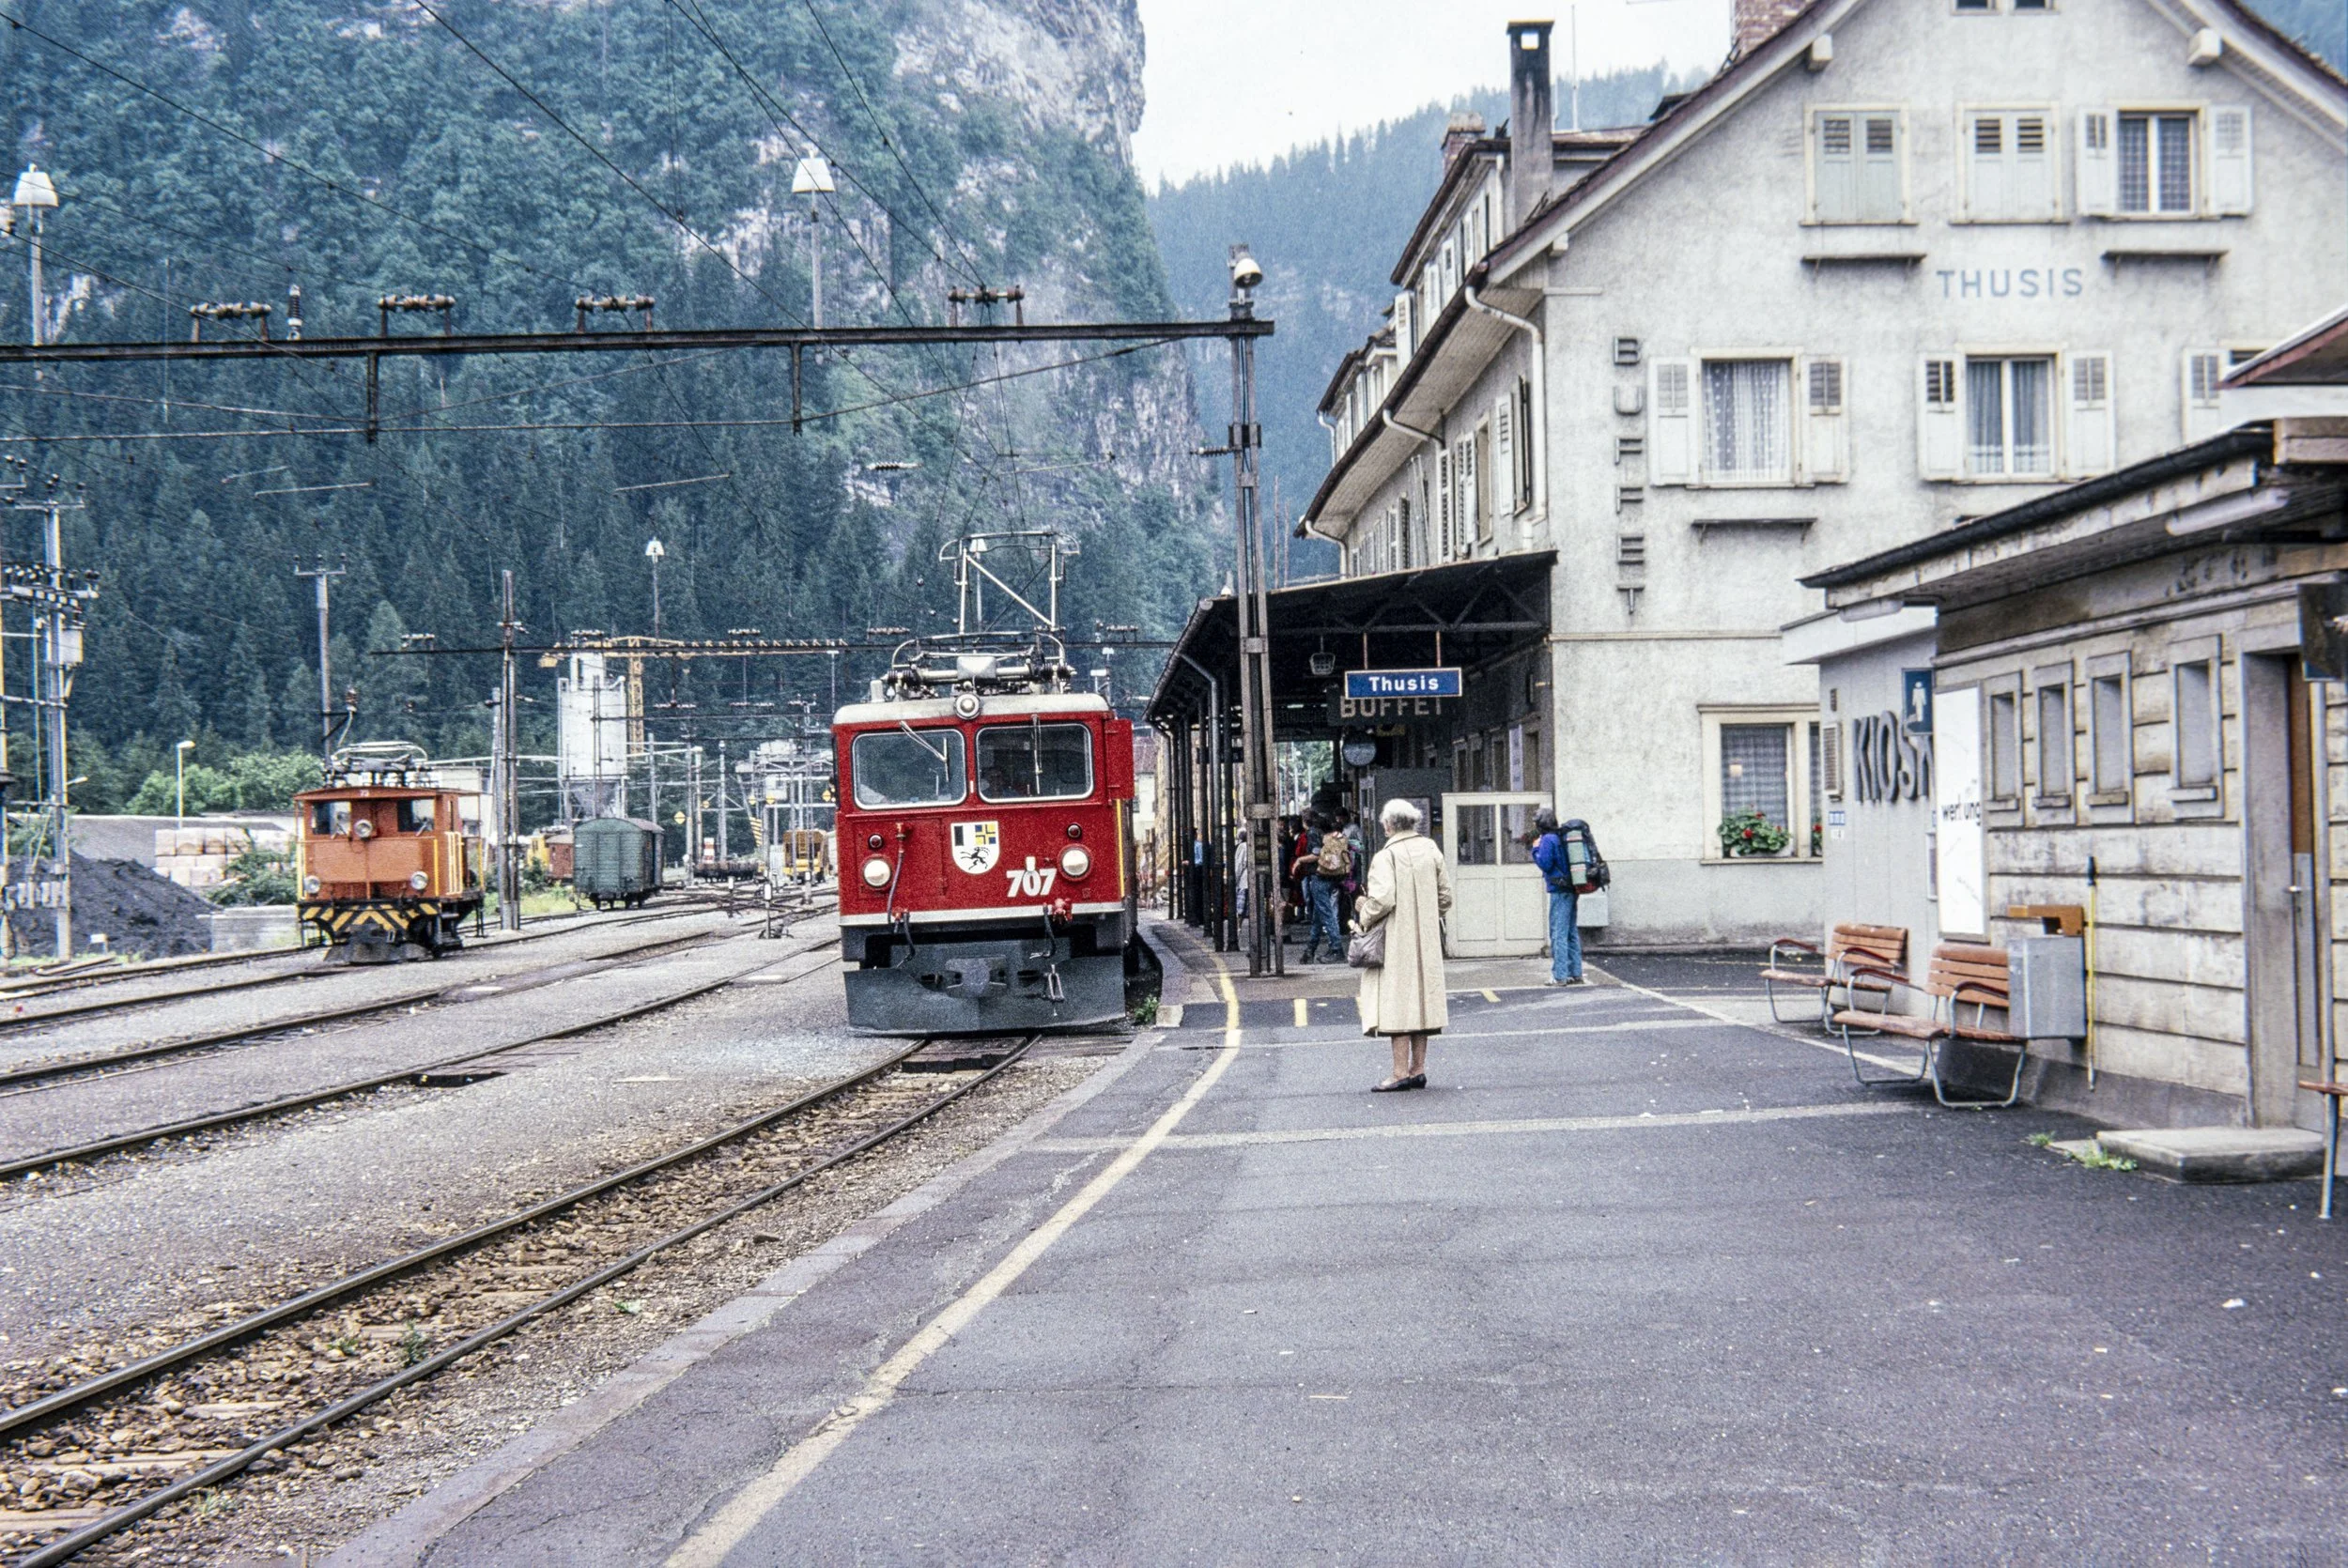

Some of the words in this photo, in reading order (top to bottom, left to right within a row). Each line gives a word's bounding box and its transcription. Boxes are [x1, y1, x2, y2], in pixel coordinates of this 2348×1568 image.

[1936, 268, 2084, 298] THUSIS
[1614, 337, 1645, 615] BUFFET
[1368, 675, 1439, 692] Thusis
[1006, 868, 1058, 898] 707
